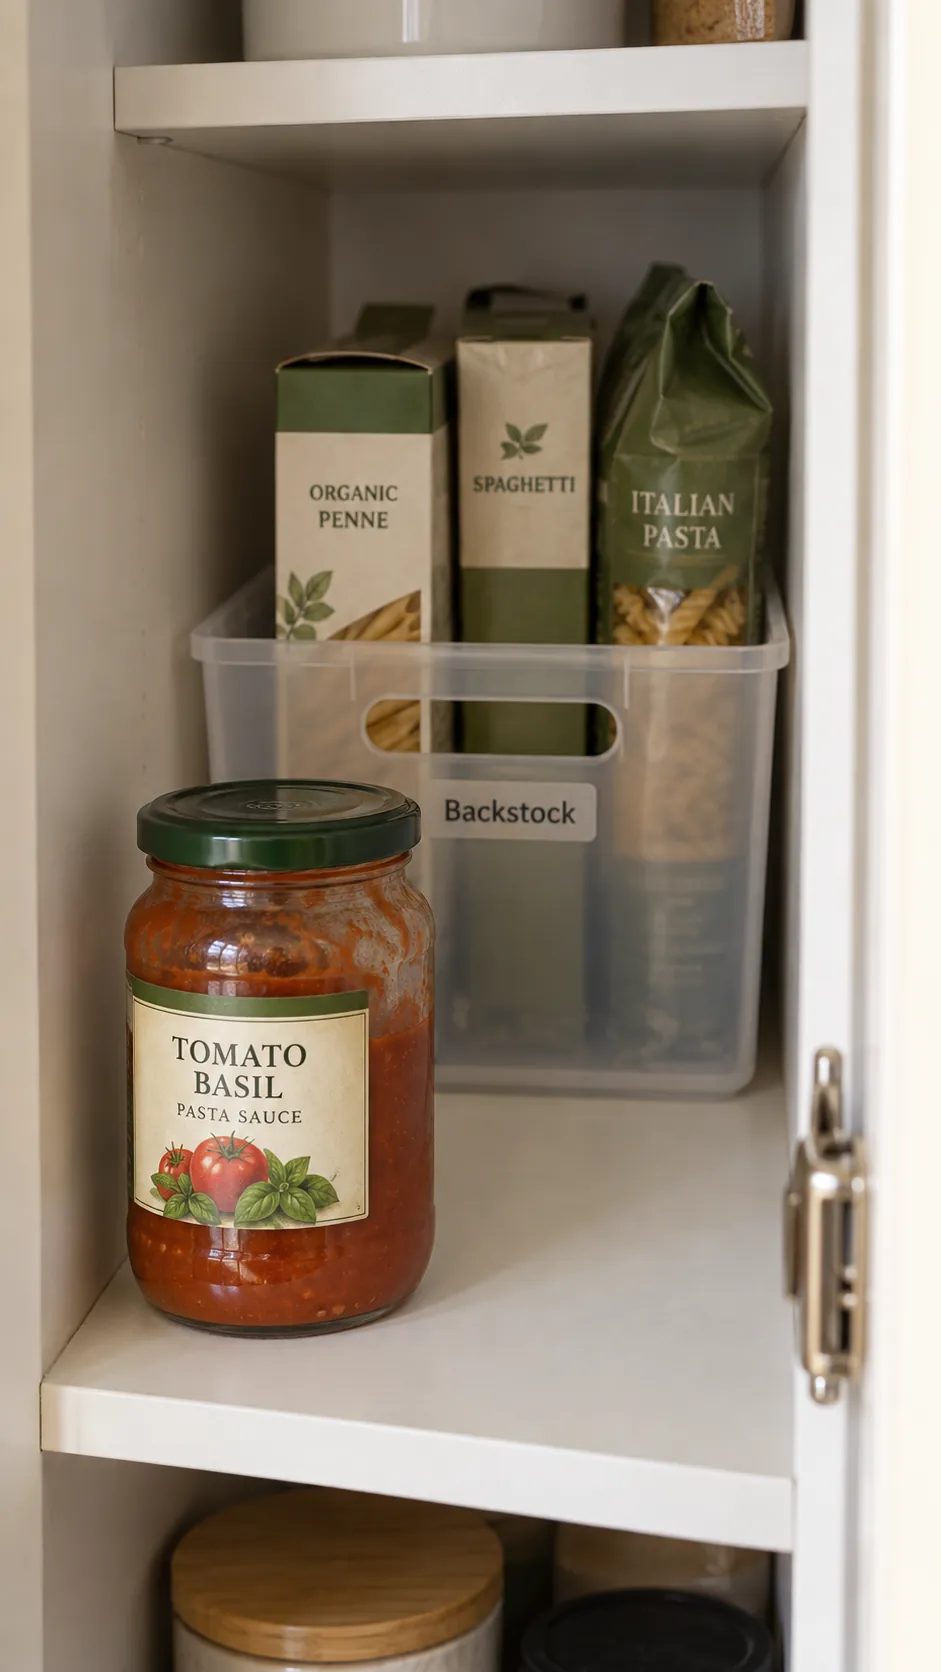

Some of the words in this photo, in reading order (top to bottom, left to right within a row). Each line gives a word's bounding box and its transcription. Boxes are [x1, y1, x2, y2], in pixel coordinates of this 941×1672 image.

[309, 484, 398, 502] ORGANIC
[472, 475, 576, 494] SPAGHETTI
[631, 490, 736, 519] ITALIAN
[319, 510, 389, 529] PENNE
[643, 524, 722, 550] PASTA
[444, 799, 576, 824] Backstock
[171, 1036, 307, 1068] TOMATO
[193, 1070, 283, 1099] BASIL
[177, 1103, 230, 1123] PASTA
[238, 1109, 302, 1125] SAUCE
